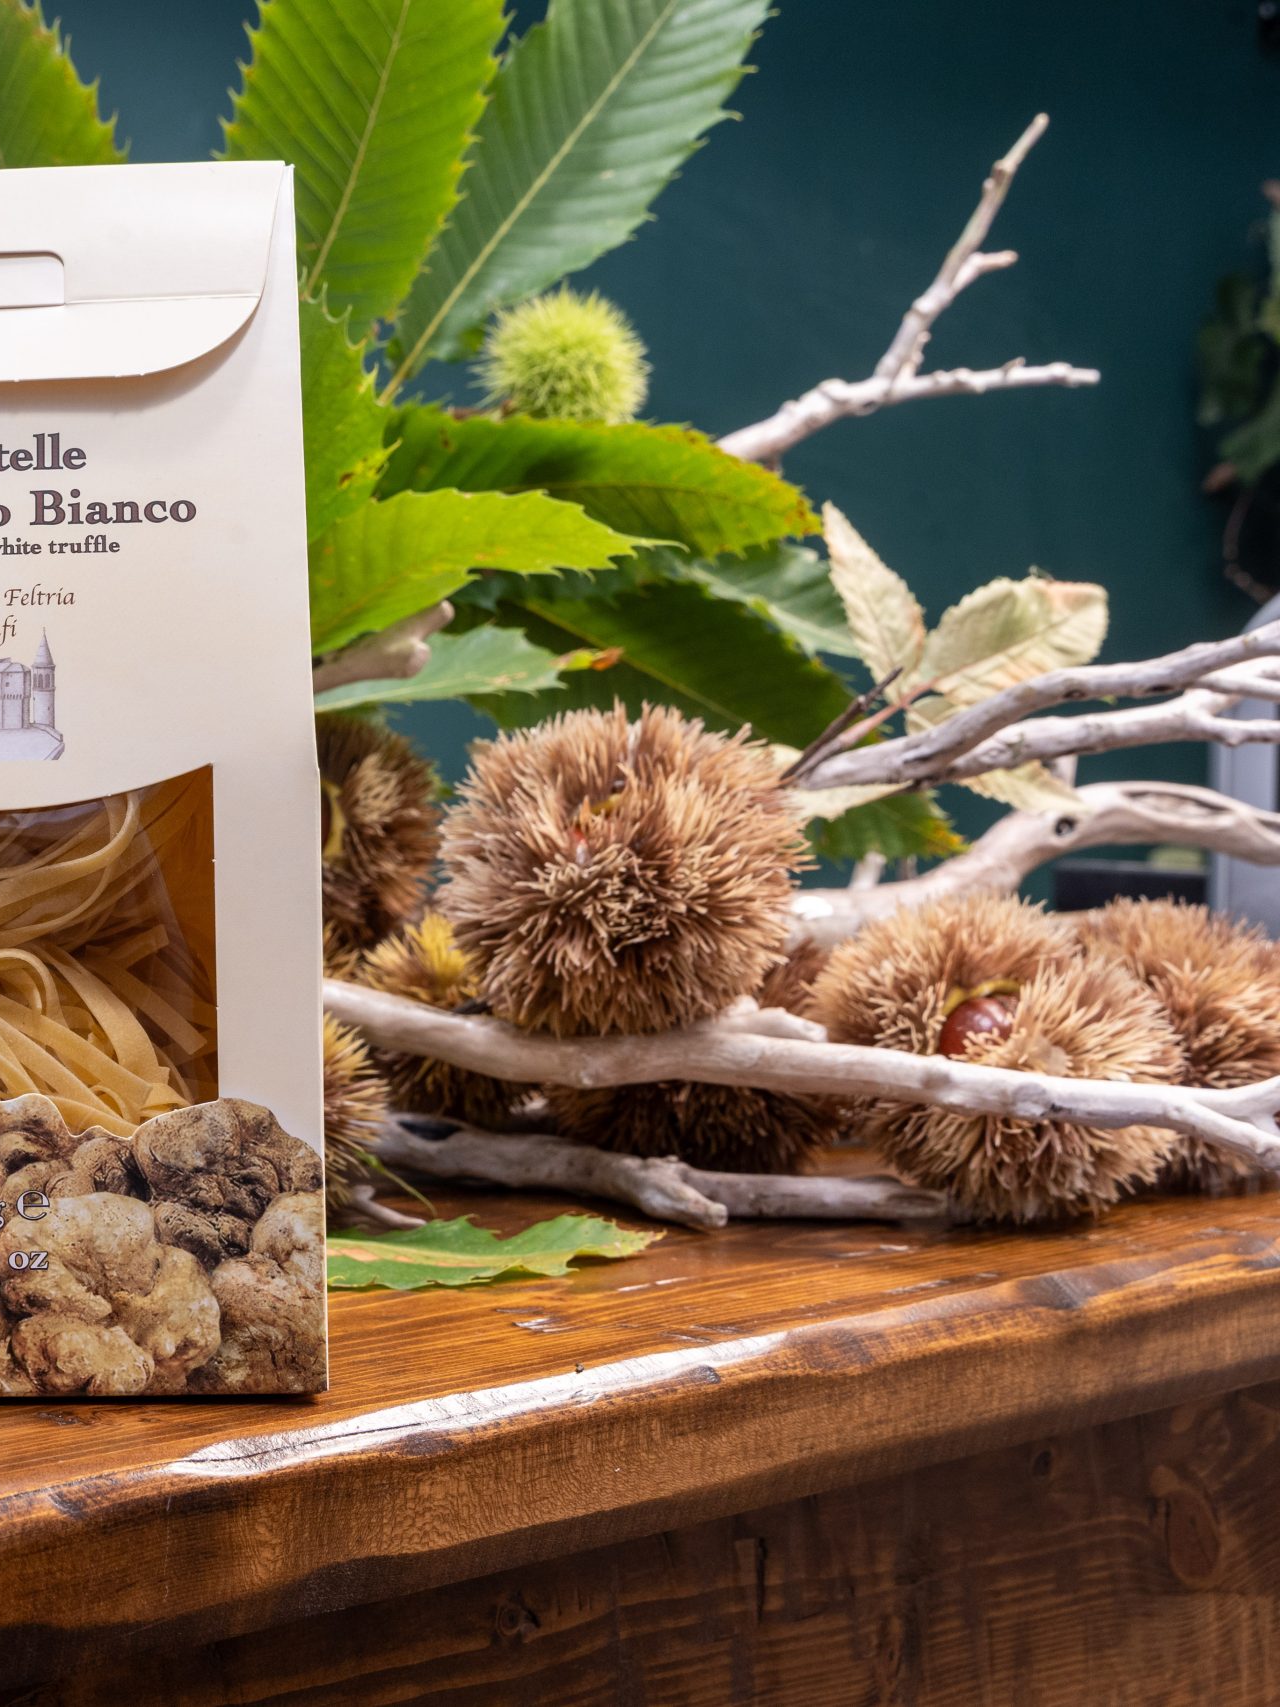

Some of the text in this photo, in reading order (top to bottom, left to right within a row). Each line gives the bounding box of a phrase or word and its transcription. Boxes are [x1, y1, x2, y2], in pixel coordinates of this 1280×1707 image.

[29, 488, 198, 526] Bianco
[48, 535, 121, 554] truffle
[3, 583, 76, 607] Feltria
[7, 1250, 50, 1271] oz
